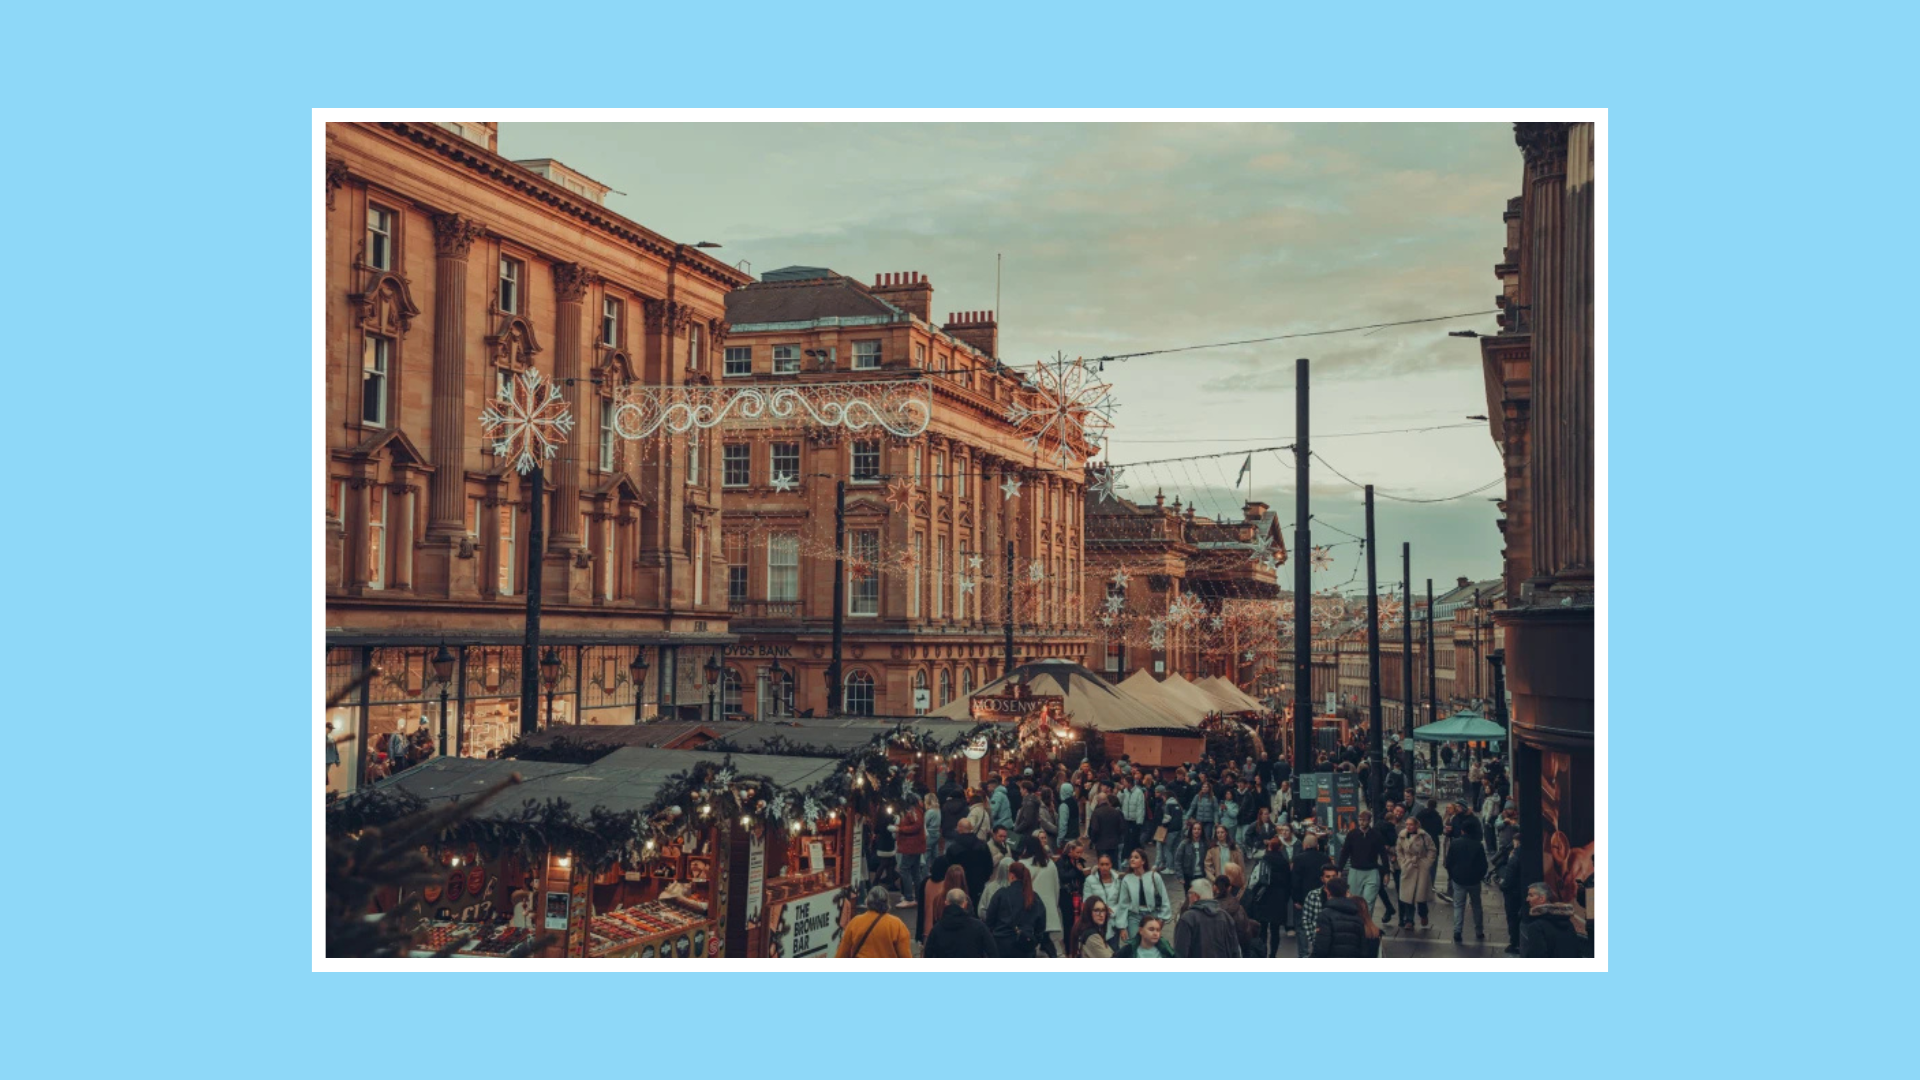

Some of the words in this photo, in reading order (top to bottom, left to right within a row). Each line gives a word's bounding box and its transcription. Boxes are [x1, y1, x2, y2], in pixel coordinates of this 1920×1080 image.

[724, 644, 755, 657] OYDS
[759, 644, 793, 657] BANK
[973, 698, 1063, 713] MOOSENW
[795, 902, 810, 921] THE
[794, 911, 830, 938] BROWNIE
[793, 934, 810, 954] BAR
